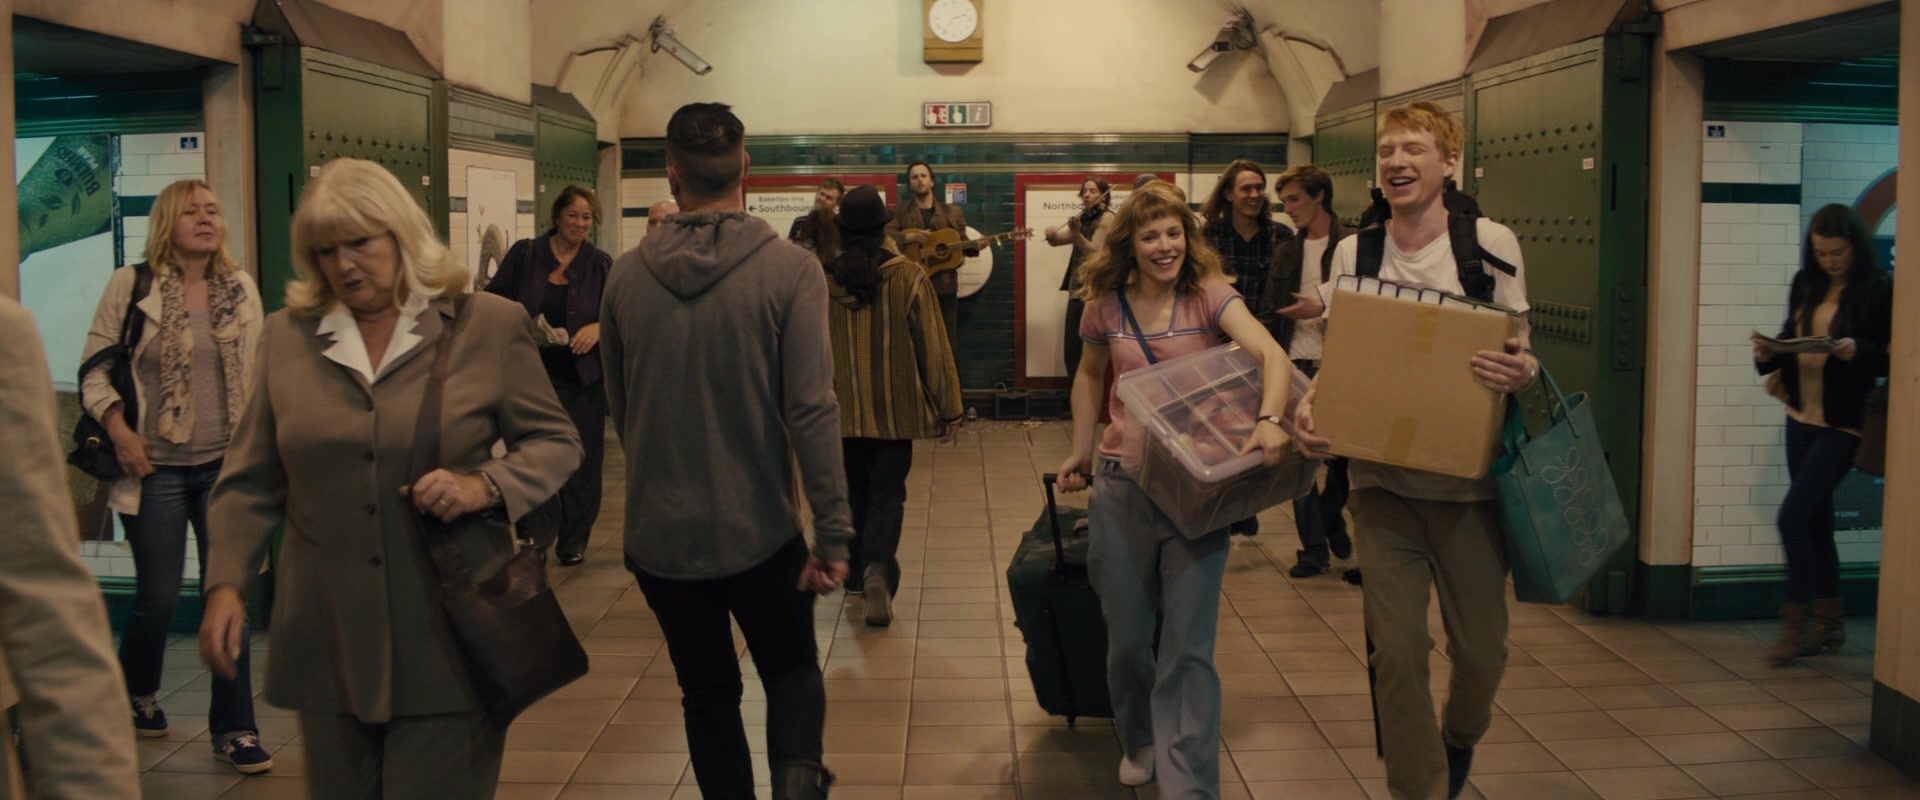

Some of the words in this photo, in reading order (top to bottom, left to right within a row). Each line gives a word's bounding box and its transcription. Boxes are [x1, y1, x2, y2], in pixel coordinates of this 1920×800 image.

[77, 146, 99, 170] PEAR
[56, 147, 101, 196] BULMERS
[759, 204, 814, 212] Southboun
